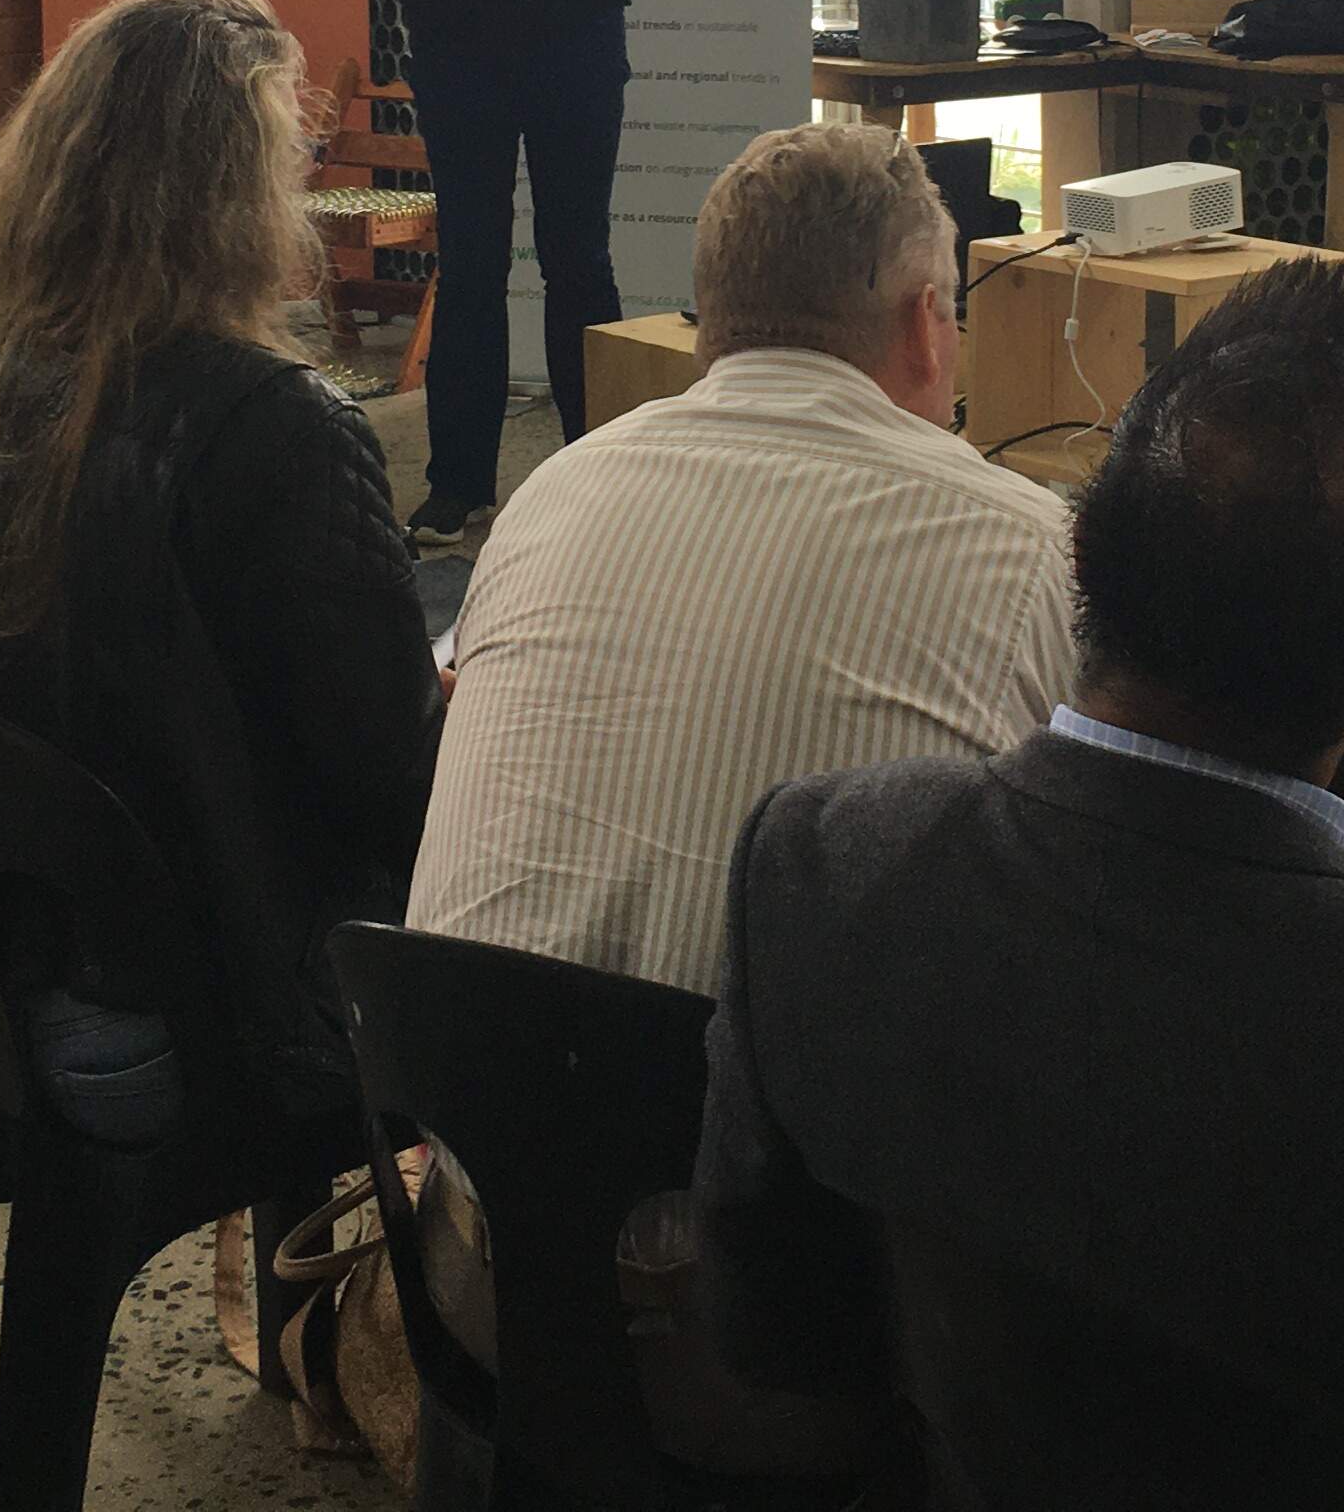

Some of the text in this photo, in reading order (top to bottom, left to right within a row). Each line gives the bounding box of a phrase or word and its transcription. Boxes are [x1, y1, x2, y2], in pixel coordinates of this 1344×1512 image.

[642, 20, 682, 31] trends
[655, 70, 678, 80] and
[680, 71, 729, 84] regional
[622, 213, 635, 222] as
[638, 213, 645, 223] a
[648, 214, 699, 224] resource
